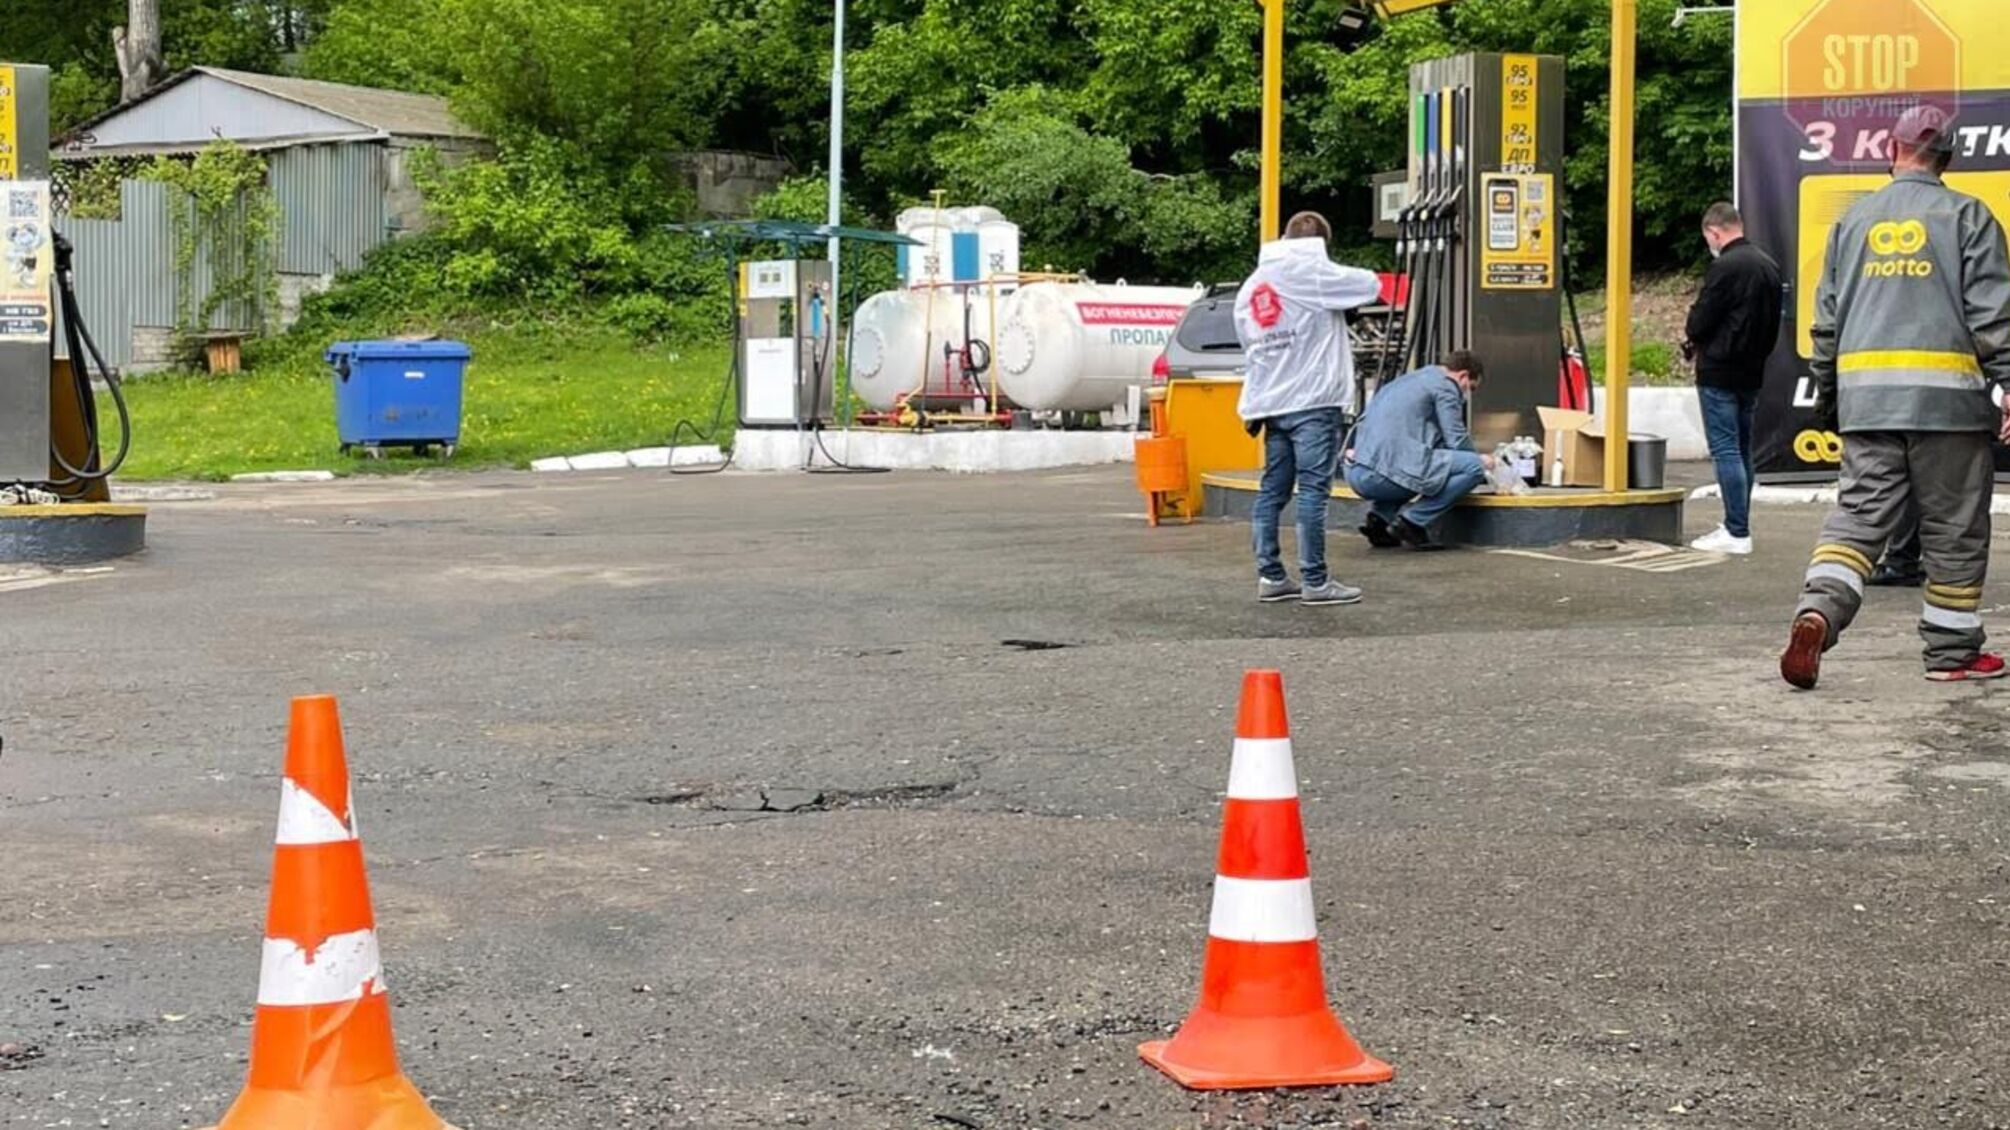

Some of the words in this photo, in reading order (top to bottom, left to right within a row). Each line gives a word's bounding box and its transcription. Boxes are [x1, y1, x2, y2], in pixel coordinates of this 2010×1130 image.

[1511, 64, 1528, 78] 95
[1511, 90, 1528, 103] 95
[1510, 123, 1528, 136] 92
[1508, 148, 1529, 162] ДП
[1863, 259, 1932, 277] motto
